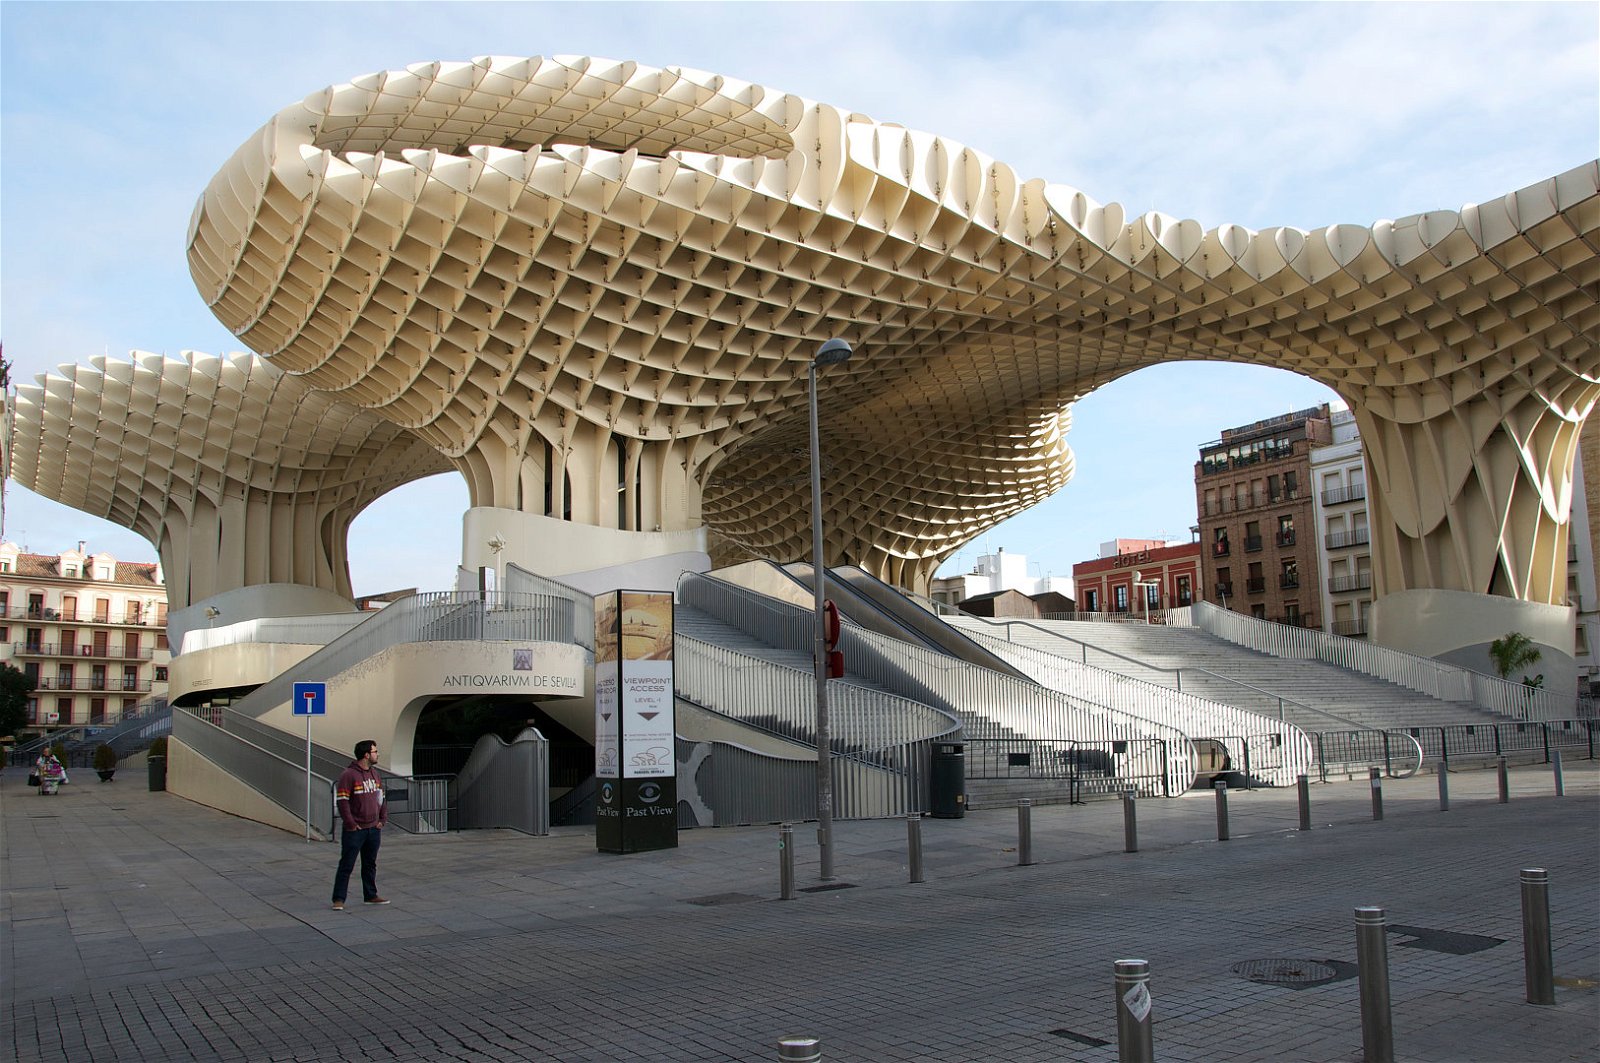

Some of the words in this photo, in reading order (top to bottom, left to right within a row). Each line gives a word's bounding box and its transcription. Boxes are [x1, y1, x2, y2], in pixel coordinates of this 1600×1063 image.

[1113, 551, 1152, 568] HOTEL
[443, 675, 530, 687] ANTIQVARIVM
[534, 676, 547, 687] DE
[550, 676, 577, 688] SEVILLA
[626, 807, 647, 817] Past
[649, 806, 673, 815] View
